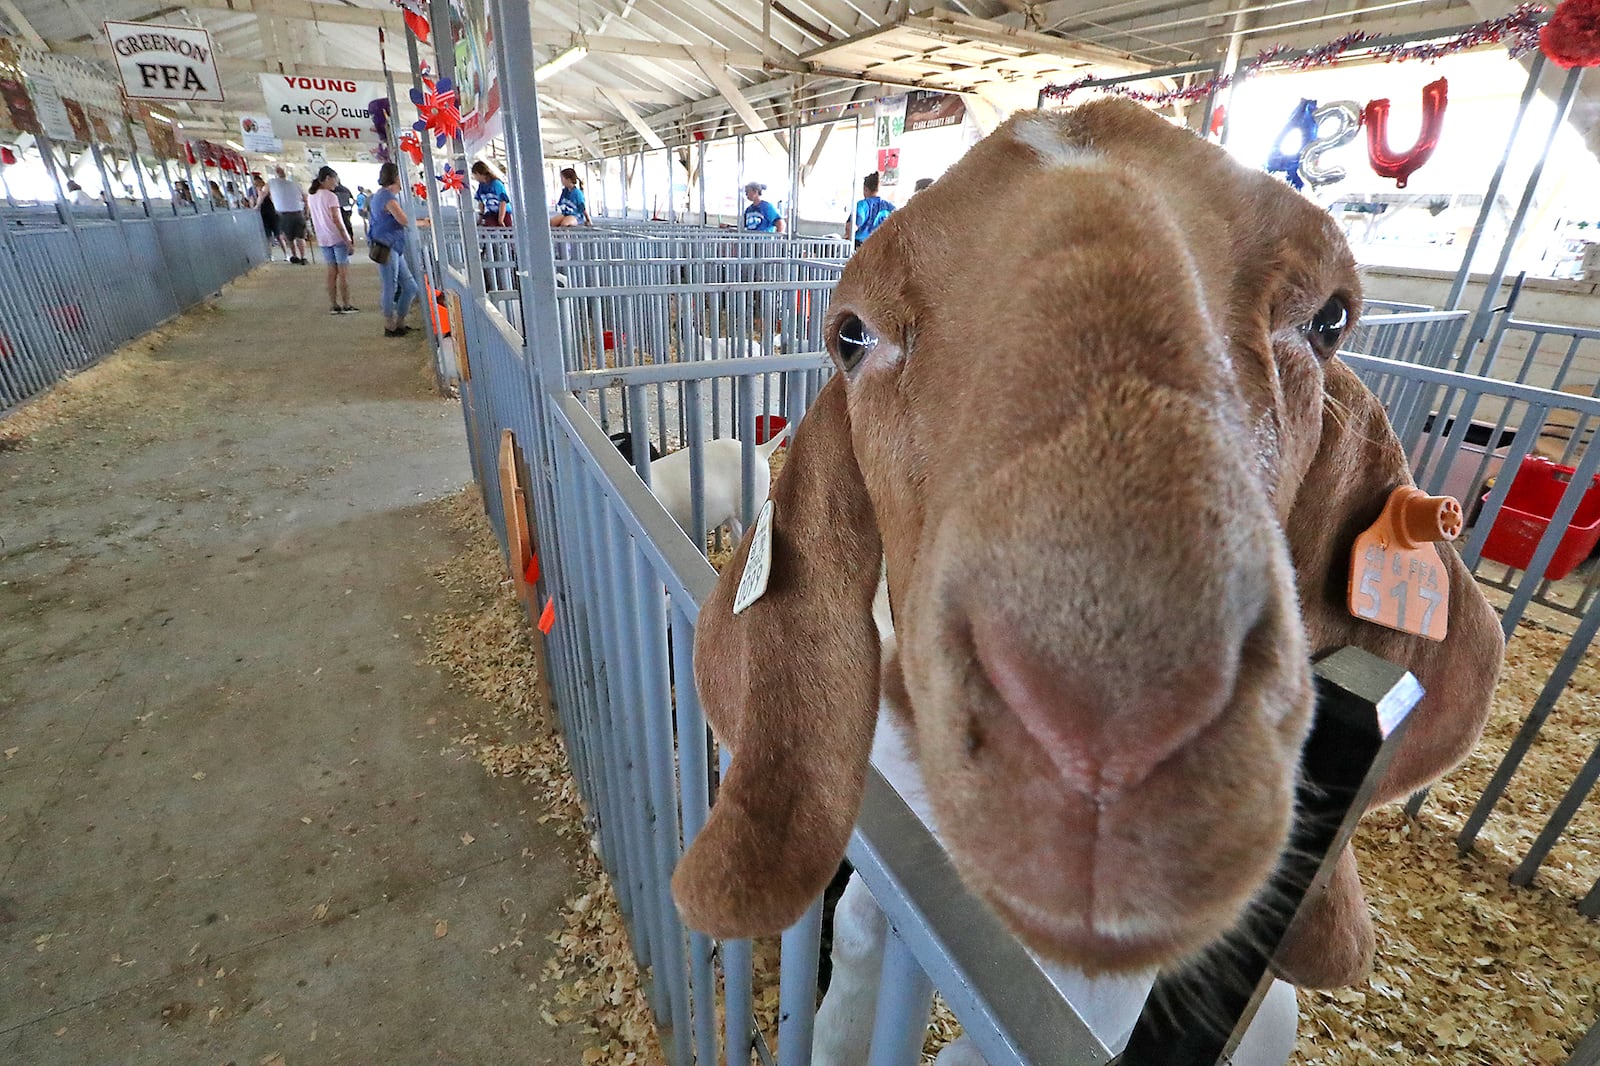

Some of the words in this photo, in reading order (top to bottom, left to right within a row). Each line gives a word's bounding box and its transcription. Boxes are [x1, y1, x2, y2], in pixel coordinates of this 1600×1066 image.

[115, 34, 208, 63] GREENON
[136, 62, 207, 91] FFA
[284, 76, 357, 93] YOUNG
[280, 104, 310, 115] 4-H
[317, 106, 331, 116] at
[341, 108, 370, 119] CLUB
[296, 125, 361, 139] HEART
[1358, 567, 1442, 635] 517
